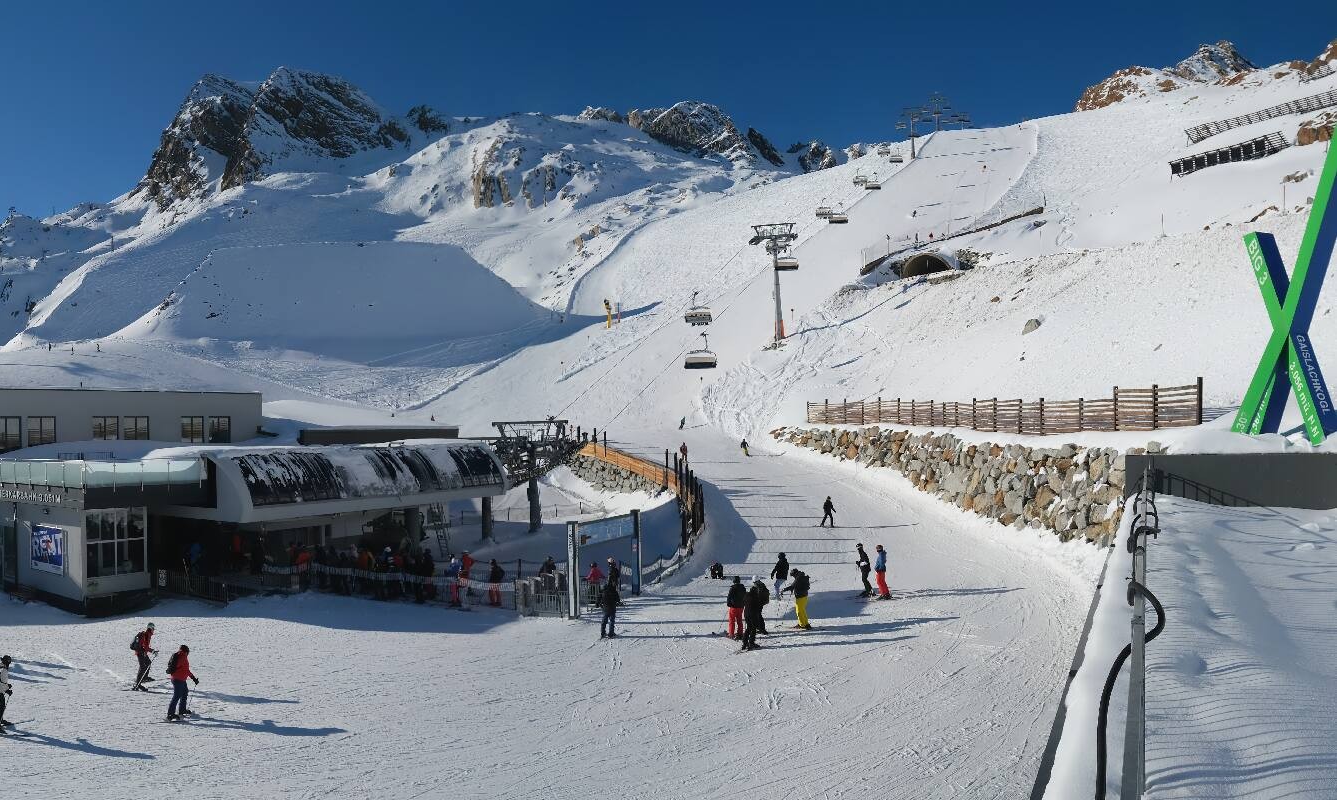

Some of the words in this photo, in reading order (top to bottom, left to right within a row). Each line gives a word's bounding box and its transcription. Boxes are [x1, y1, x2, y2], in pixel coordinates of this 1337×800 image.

[1249, 237, 1263, 271] BIG
[1259, 271, 1268, 285] 3
[1296, 334, 1331, 415] GAISLACHKOGL
